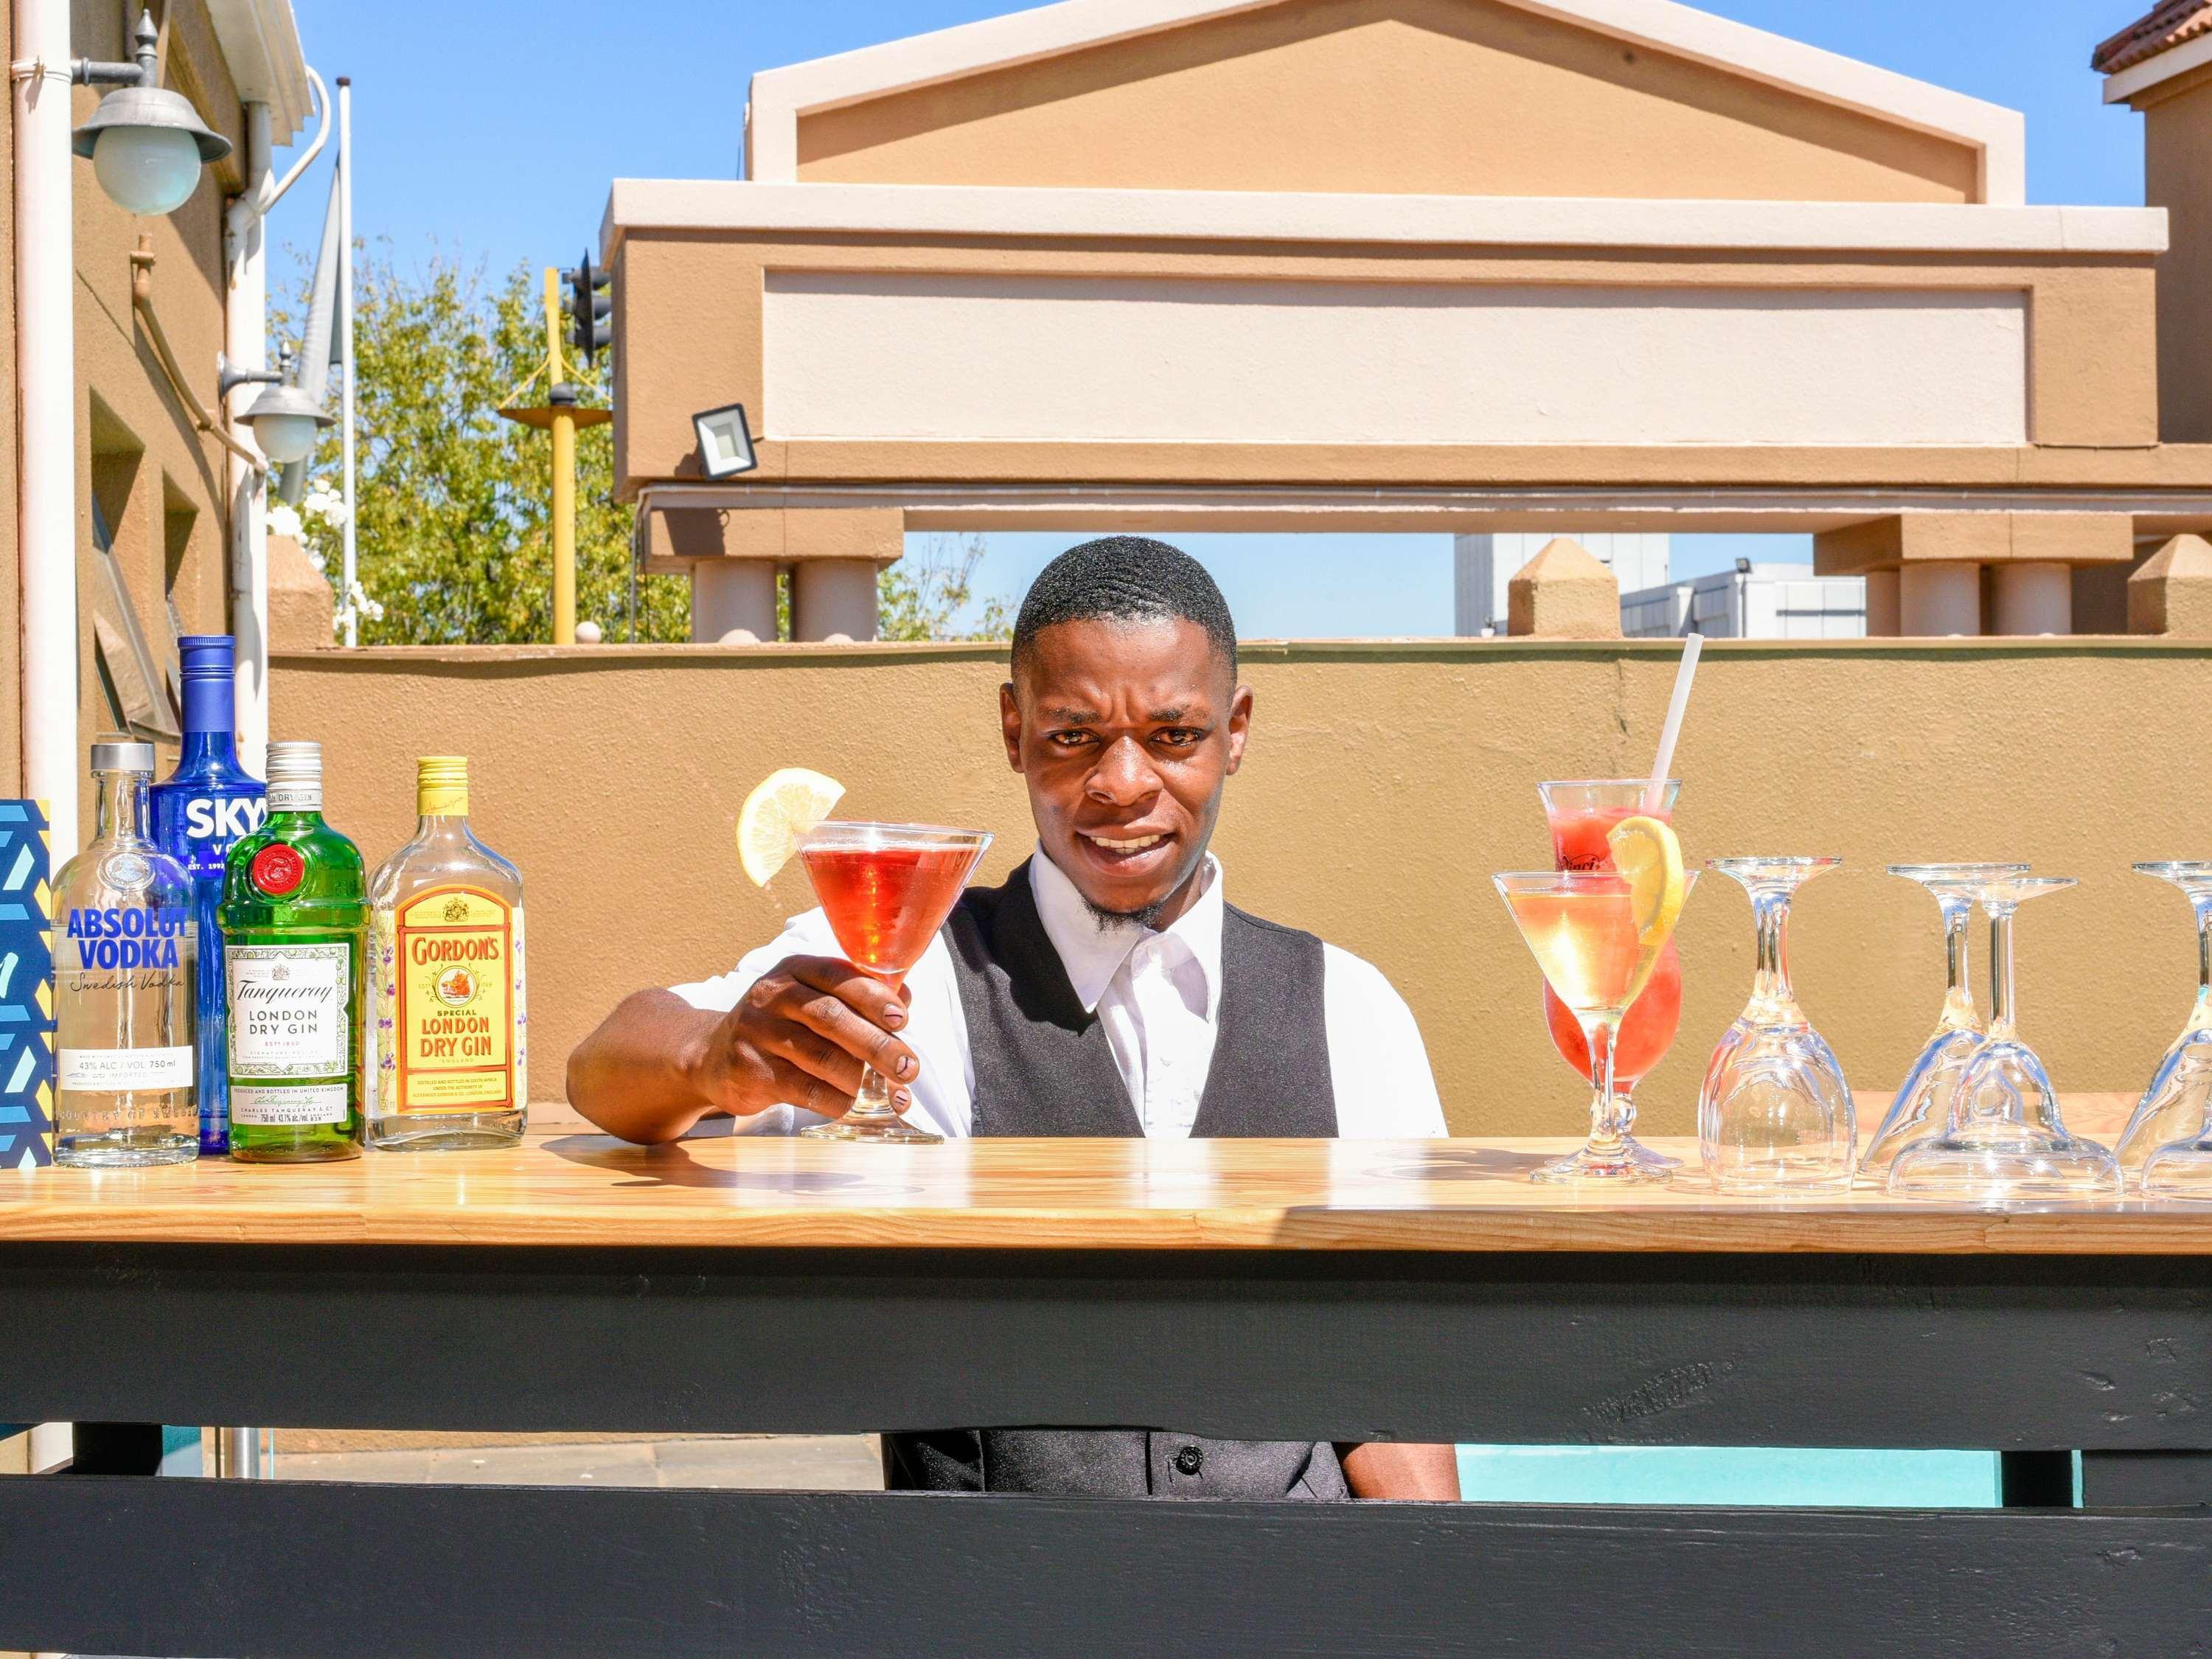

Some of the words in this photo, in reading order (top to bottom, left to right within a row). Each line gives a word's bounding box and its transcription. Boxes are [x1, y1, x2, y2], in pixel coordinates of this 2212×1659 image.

[186, 798, 268, 838] SKY
[66, 908, 188, 938] ABSOLUT
[77, 939, 179, 970] VODKA
[411, 936, 499, 965] GORDON'S
[70, 972, 136, 992] Swedish
[140, 970, 185, 990] Vodka
[237, 979, 333, 1004] Tanqueray
[249, 1009, 317, 1021] LONDON
[437, 1009, 477, 1017] SPECIAL
[249, 1024, 279, 1034] DRY
[288, 1023, 317, 1034] GIN
[421, 1017, 490, 1034] LONDON
[420, 1037, 457, 1057] DRY
[461, 1036, 493, 1056] GIN
[79, 1062, 97, 1070] 43%
[100, 1061, 117, 1070] ALC
[126, 1061, 145, 1069] VOL
